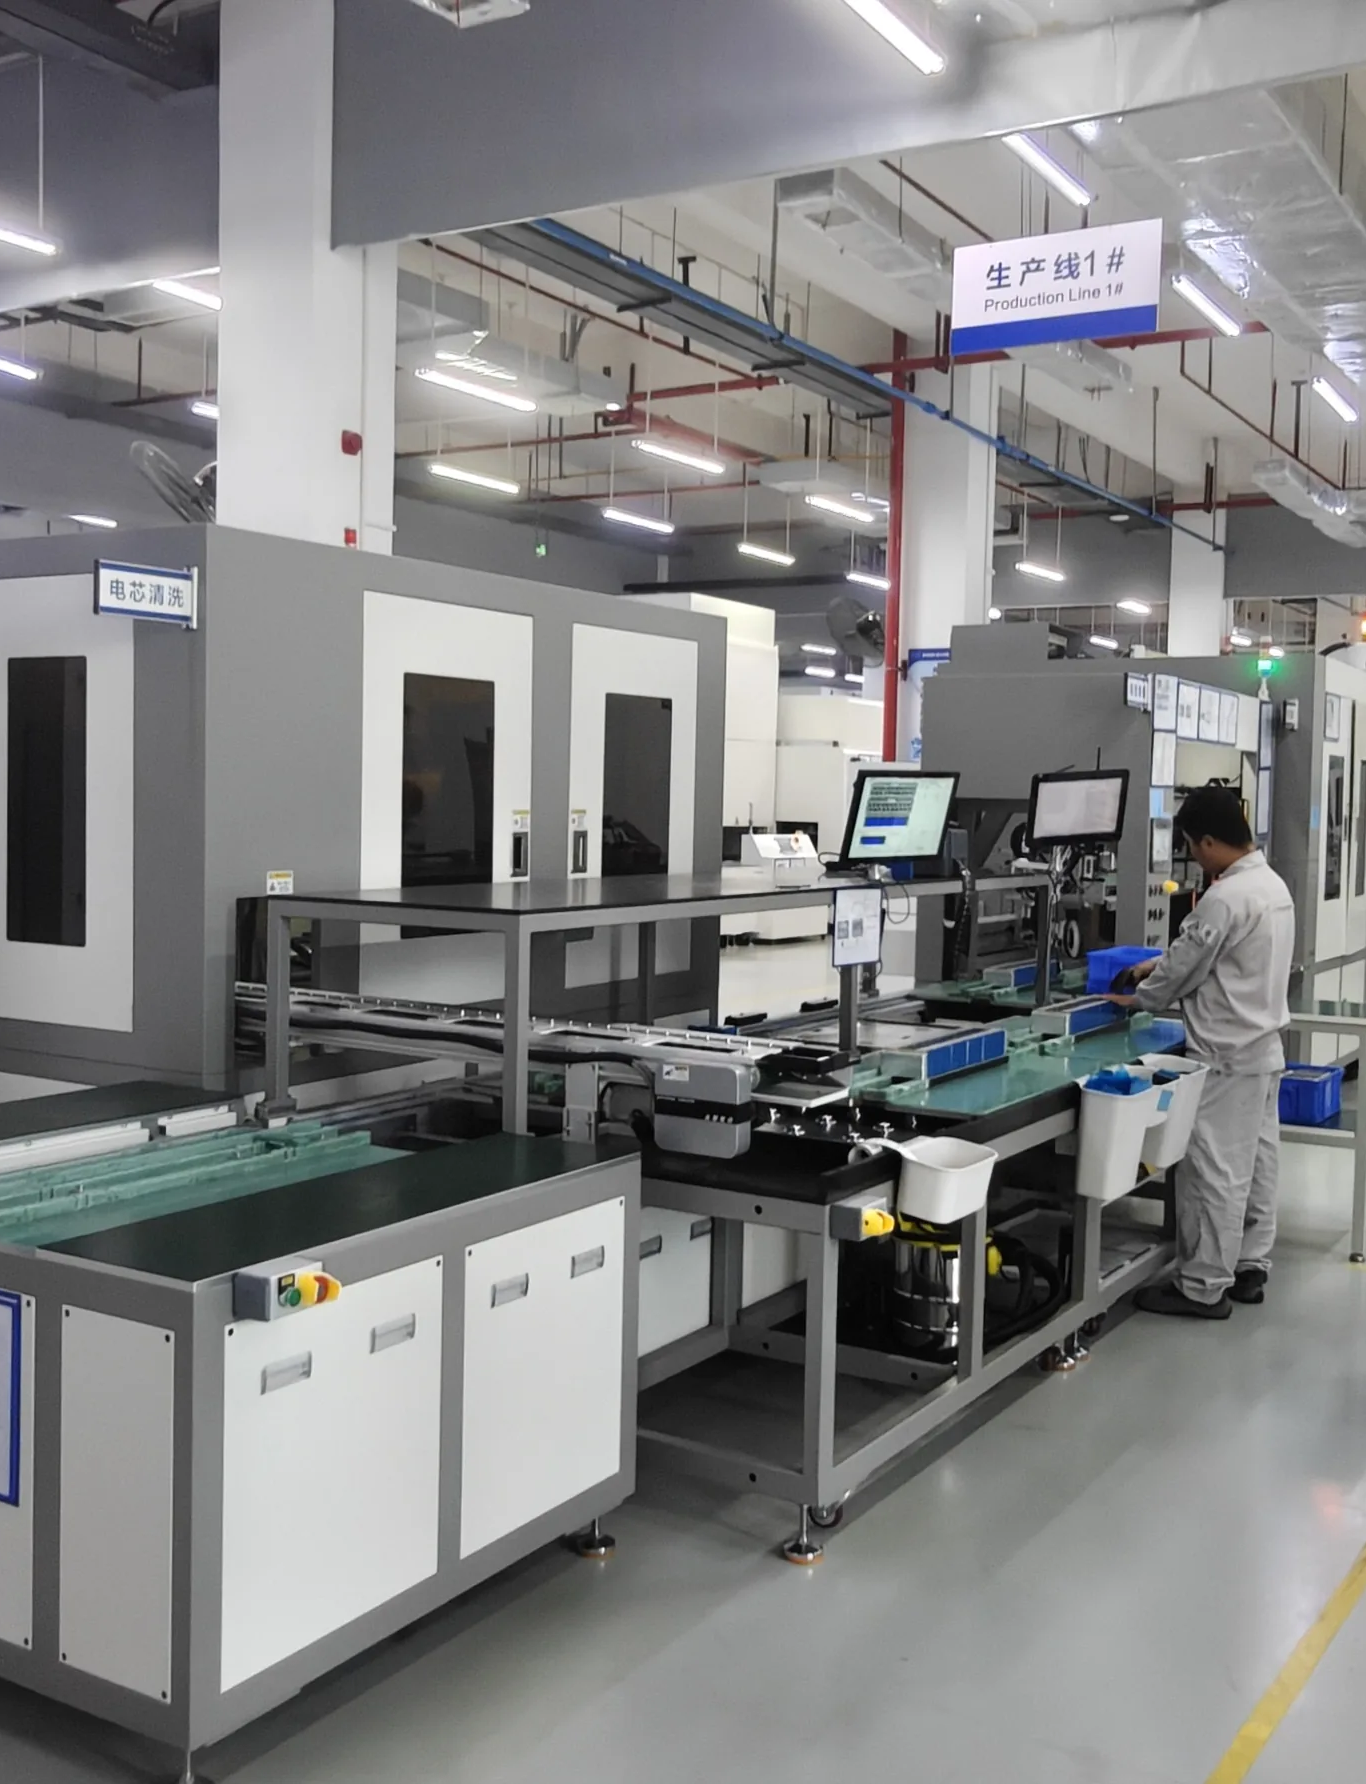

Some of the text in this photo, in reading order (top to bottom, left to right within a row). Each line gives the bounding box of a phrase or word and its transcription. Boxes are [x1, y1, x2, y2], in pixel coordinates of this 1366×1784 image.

[984, 281, 1124, 312] Production Line 1#
[109, 578, 185, 608] 电芯清洗
